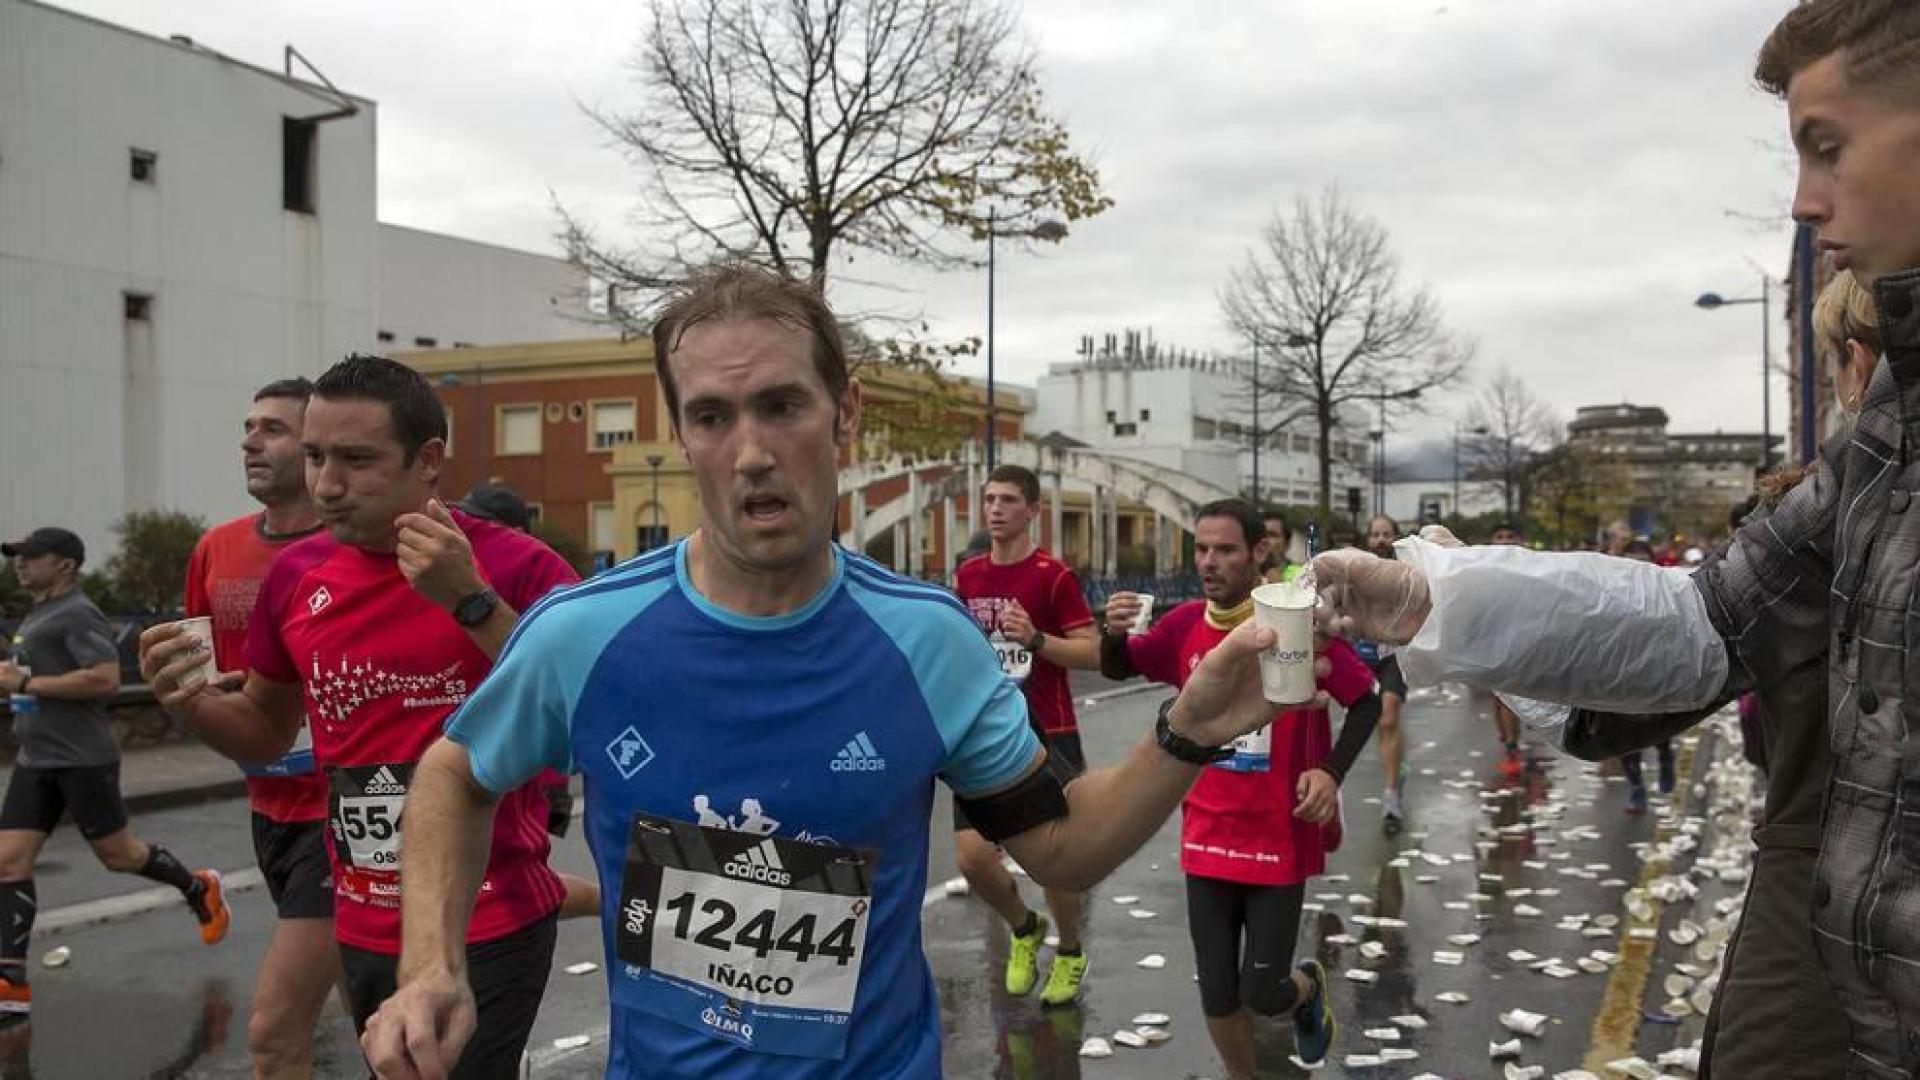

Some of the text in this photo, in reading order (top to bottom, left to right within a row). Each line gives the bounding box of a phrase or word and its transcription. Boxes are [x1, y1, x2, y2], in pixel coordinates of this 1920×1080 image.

[830, 756, 886, 772] adidas
[373, 850, 400, 864] OS
[724, 861, 792, 886] adidas
[665, 890, 858, 967] 12444
[706, 962, 794, 997] IÑACO
